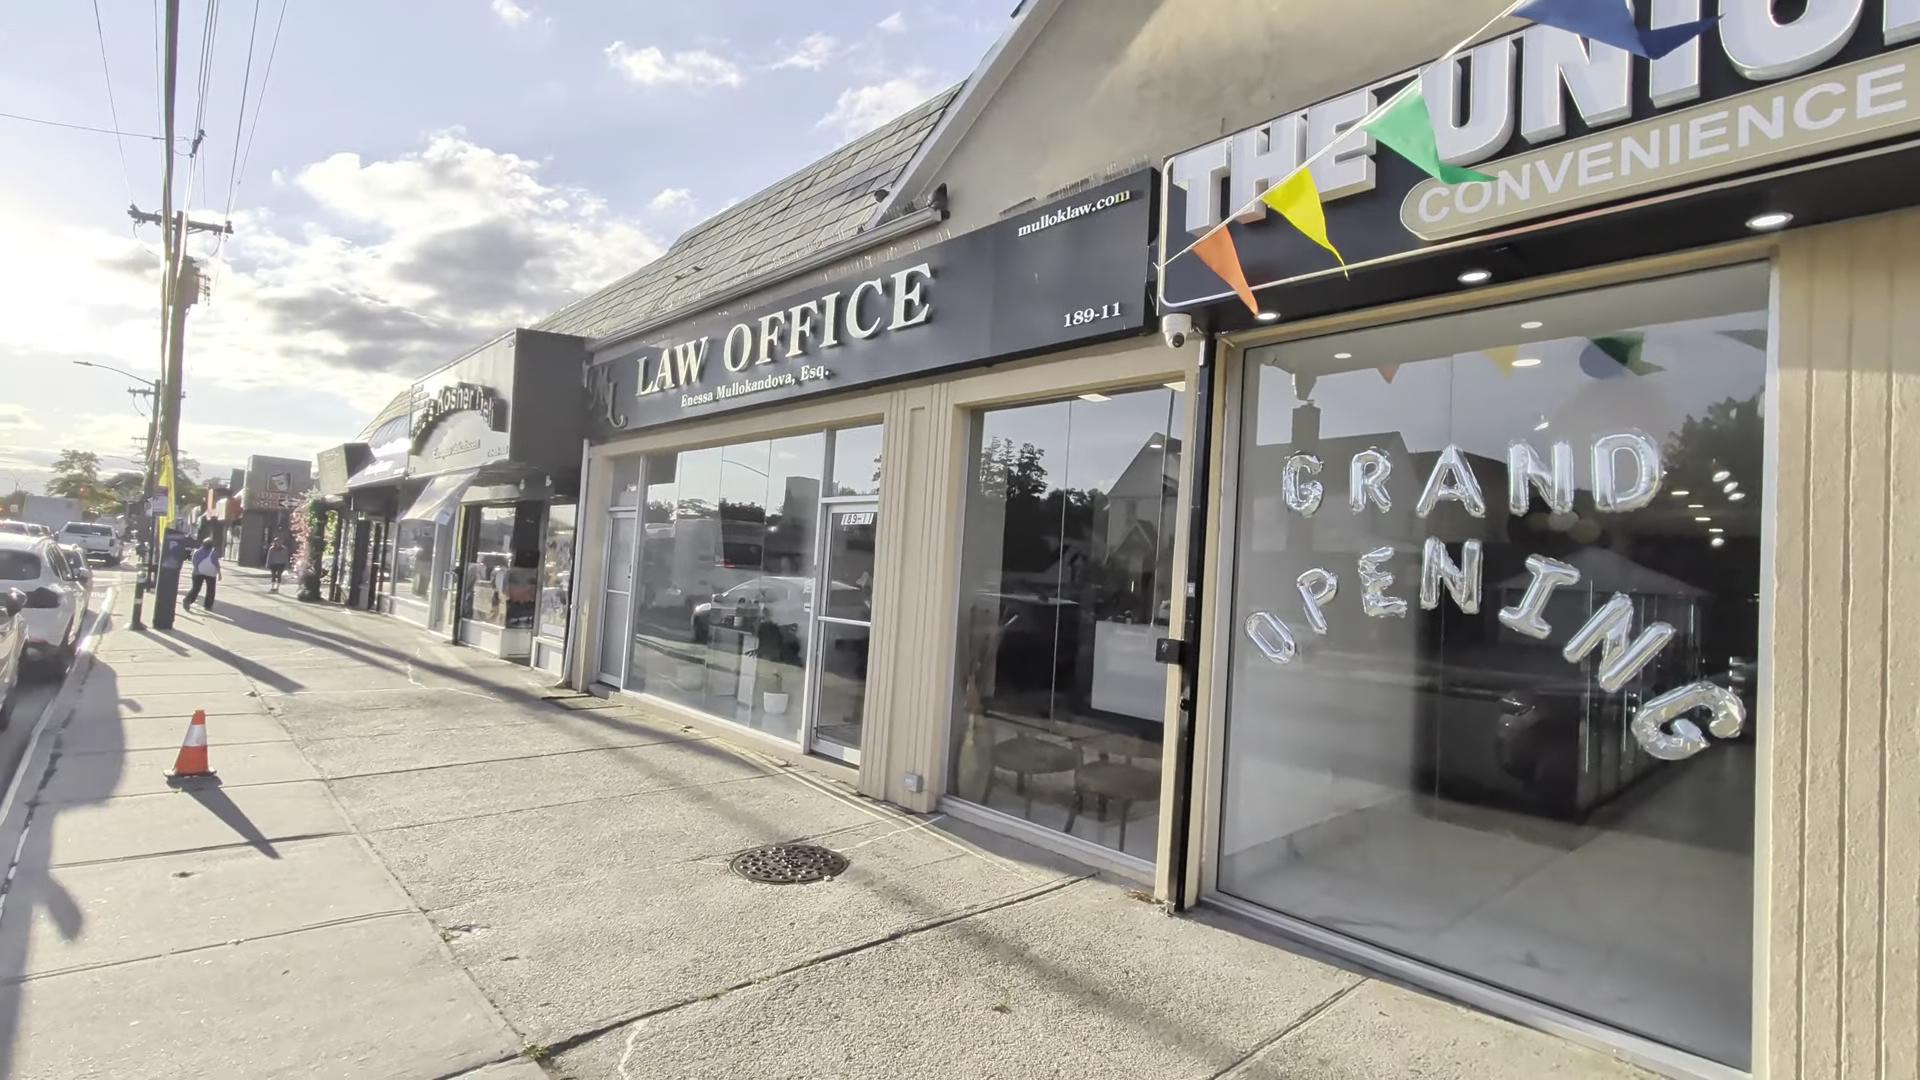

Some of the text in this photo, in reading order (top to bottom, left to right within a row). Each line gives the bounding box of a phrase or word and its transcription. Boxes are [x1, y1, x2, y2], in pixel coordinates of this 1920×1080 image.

[1172, 0, 1920, 238] THE UNIO
[1417, 62, 1908, 224] CONVENIENCE
[1017, 189, 1132, 238] mulloklaw.com
[636, 262, 934, 397] LAW OFFICE
[1062, 300, 1122, 330] 189-11
[680, 363, 831, 408] Enessa Mullokandova, Esq.
[841, 513, 874, 525] 189-11
[1282, 426, 1664, 519] GRAND
[1243, 536, 1746, 762] OPENING
